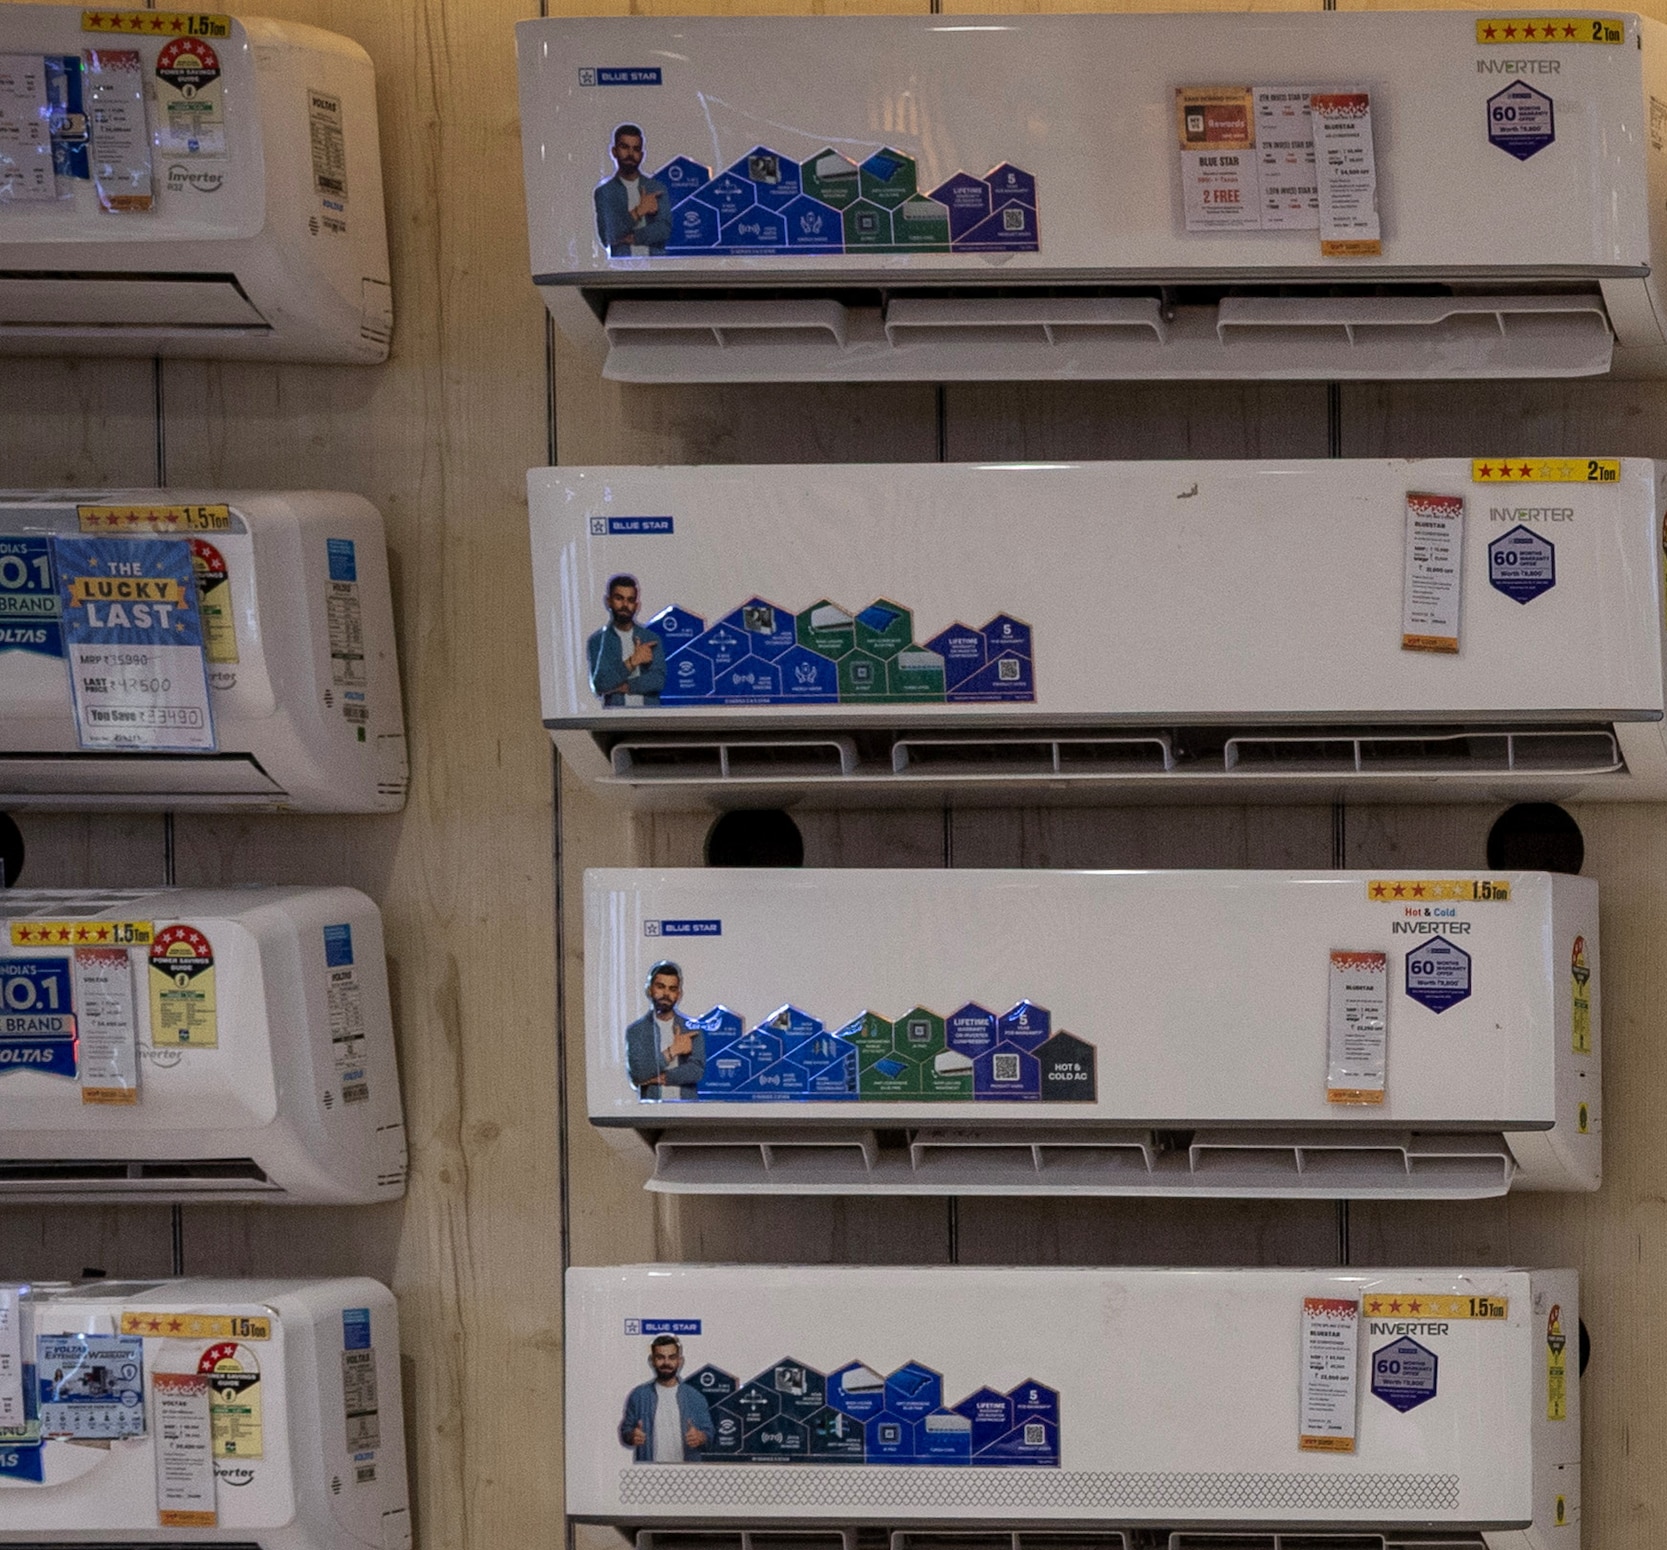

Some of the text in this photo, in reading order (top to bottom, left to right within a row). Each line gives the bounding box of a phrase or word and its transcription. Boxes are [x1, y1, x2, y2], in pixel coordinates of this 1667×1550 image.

[1588, 461, 1615, 480] 2 Ton
[183, 508, 229, 529] 1.5 Ton
[1490, 508, 1574, 522] INVERTER
[1494, 551, 1517, 566] 60
[108, 562, 142, 576] THE
[84, 580, 170, 598] LUCKY
[87, 603, 173, 629] LAST
[1472, 882, 1508, 899] 1.5 Ton
[1405, 908, 1455, 916] Hot & Cold
[1393, 922, 1471, 934] INVERTER
[1411, 961, 1434, 975] 60
[7, 1018, 62, 1031] BRAND
[1048, 1072, 1070, 1080] COLD
[645, 1323, 697, 1331] BLUE STAR
[1370, 1323, 1448, 1335] INVERTER
